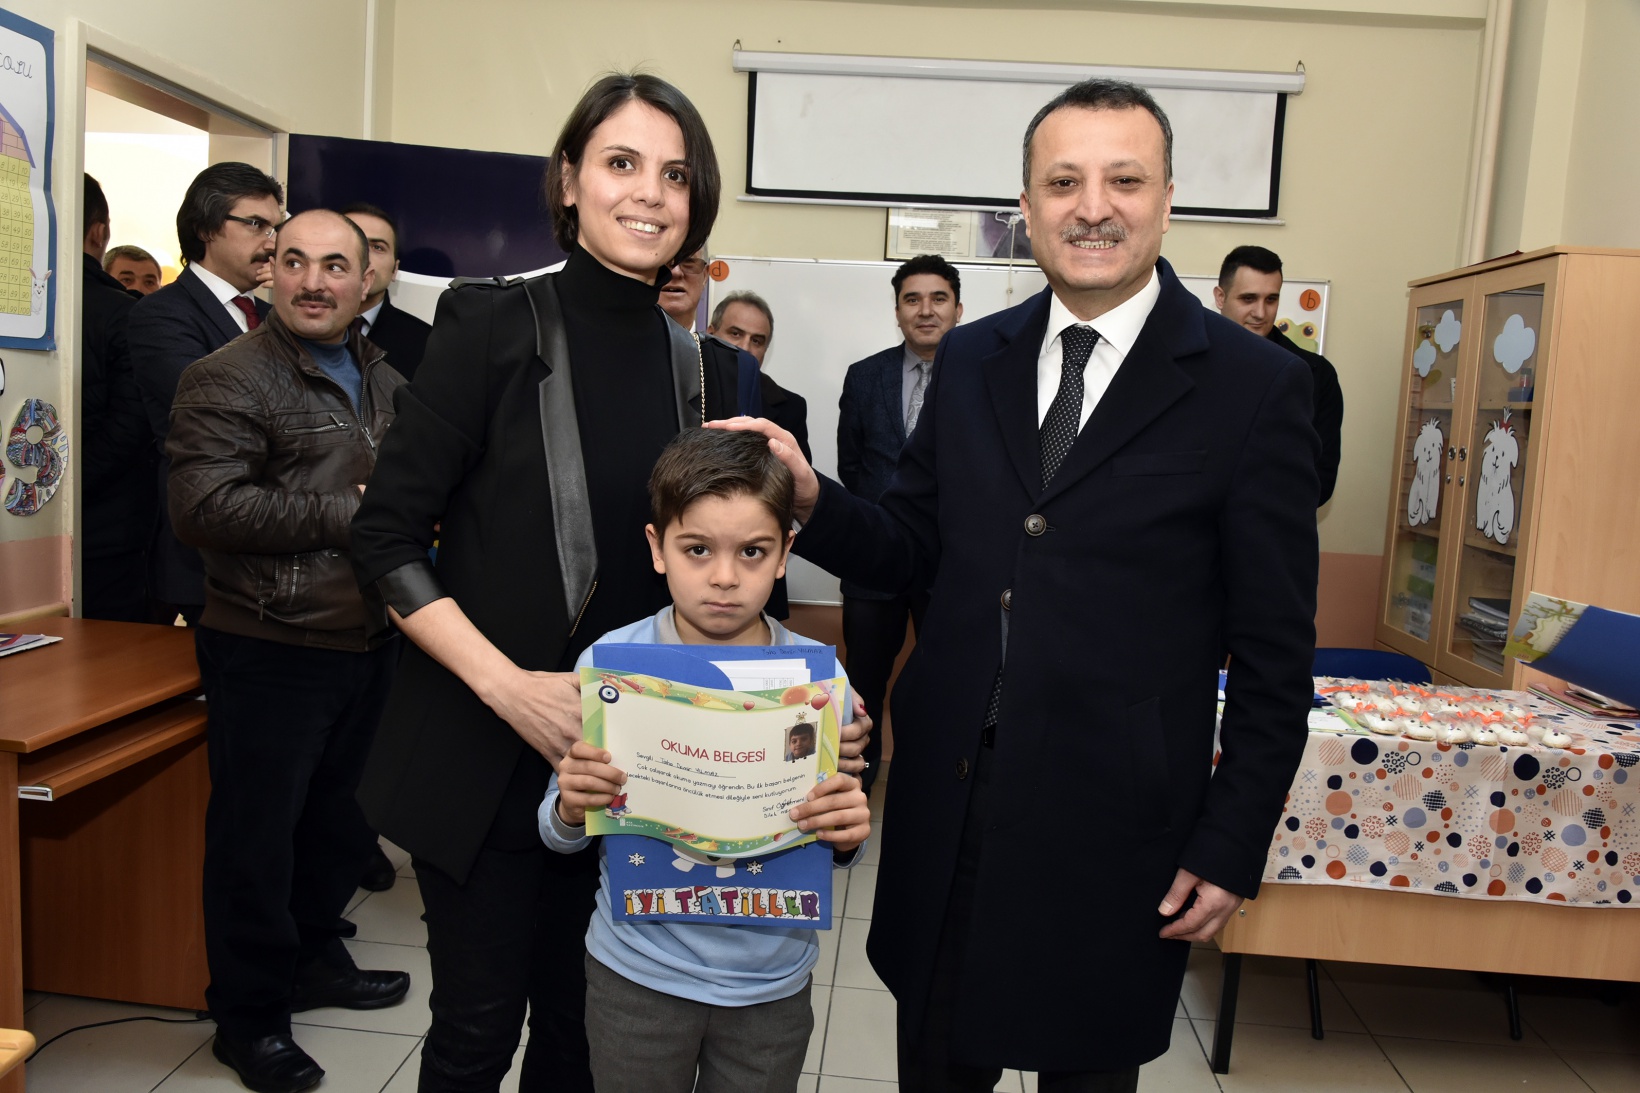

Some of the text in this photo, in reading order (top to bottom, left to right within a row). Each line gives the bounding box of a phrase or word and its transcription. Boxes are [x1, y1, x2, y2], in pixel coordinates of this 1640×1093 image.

[1307, 291, 1316, 309] b
[636, 751, 654, 762] Sevgili
[660, 738, 766, 763] OKUMA BELGESİ
[636, 763, 648, 771] Çok
[673, 773, 692, 784] okuma
[626, 771, 651, 782] lecekteki
[705, 793, 724, 801] etmesi
[624, 885, 820, 920] İYİ TATİLLER
